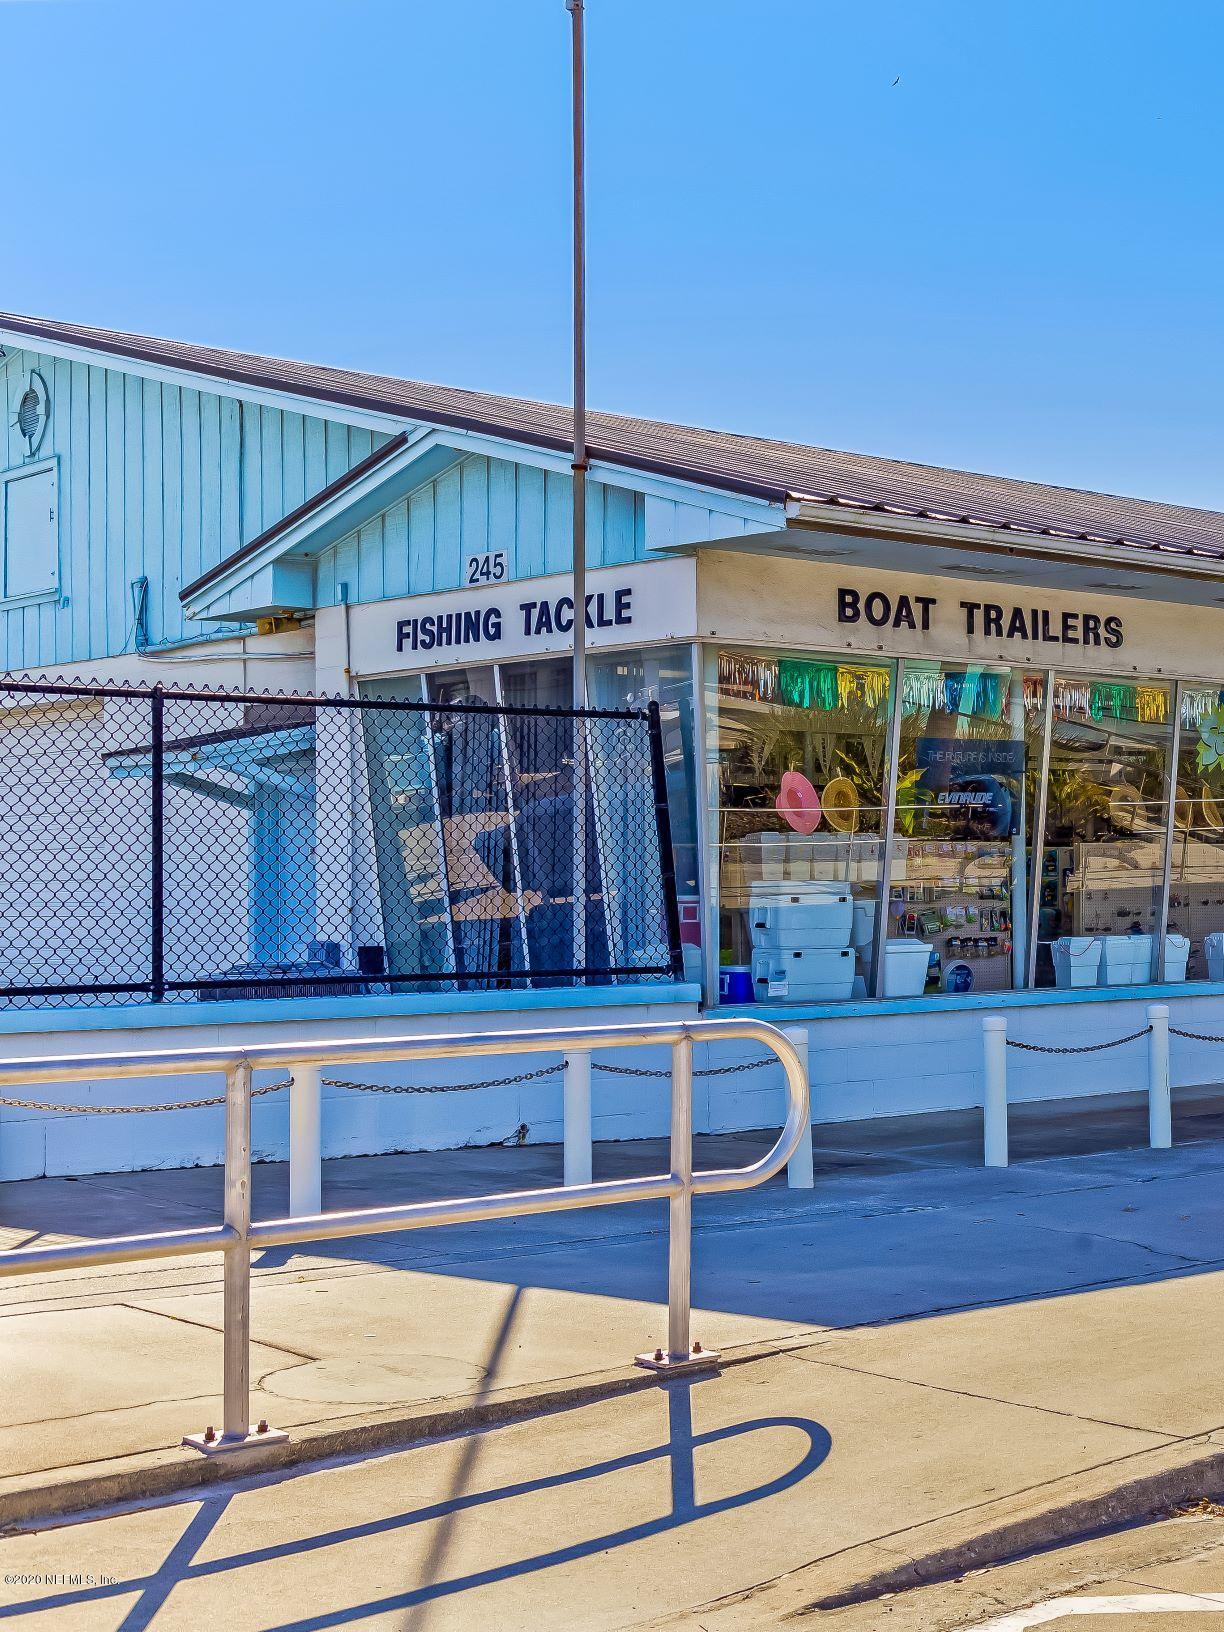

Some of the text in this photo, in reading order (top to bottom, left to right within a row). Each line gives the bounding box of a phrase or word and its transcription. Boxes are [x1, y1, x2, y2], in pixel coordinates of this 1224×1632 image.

[468, 553, 505, 583] 245
[396, 588, 632, 653] FISHING TACKLE
[837, 587, 1124, 649] BOAT TRAILERS
[928, 751, 944, 762] THE
[937, 792, 994, 804] EVINRUDE
